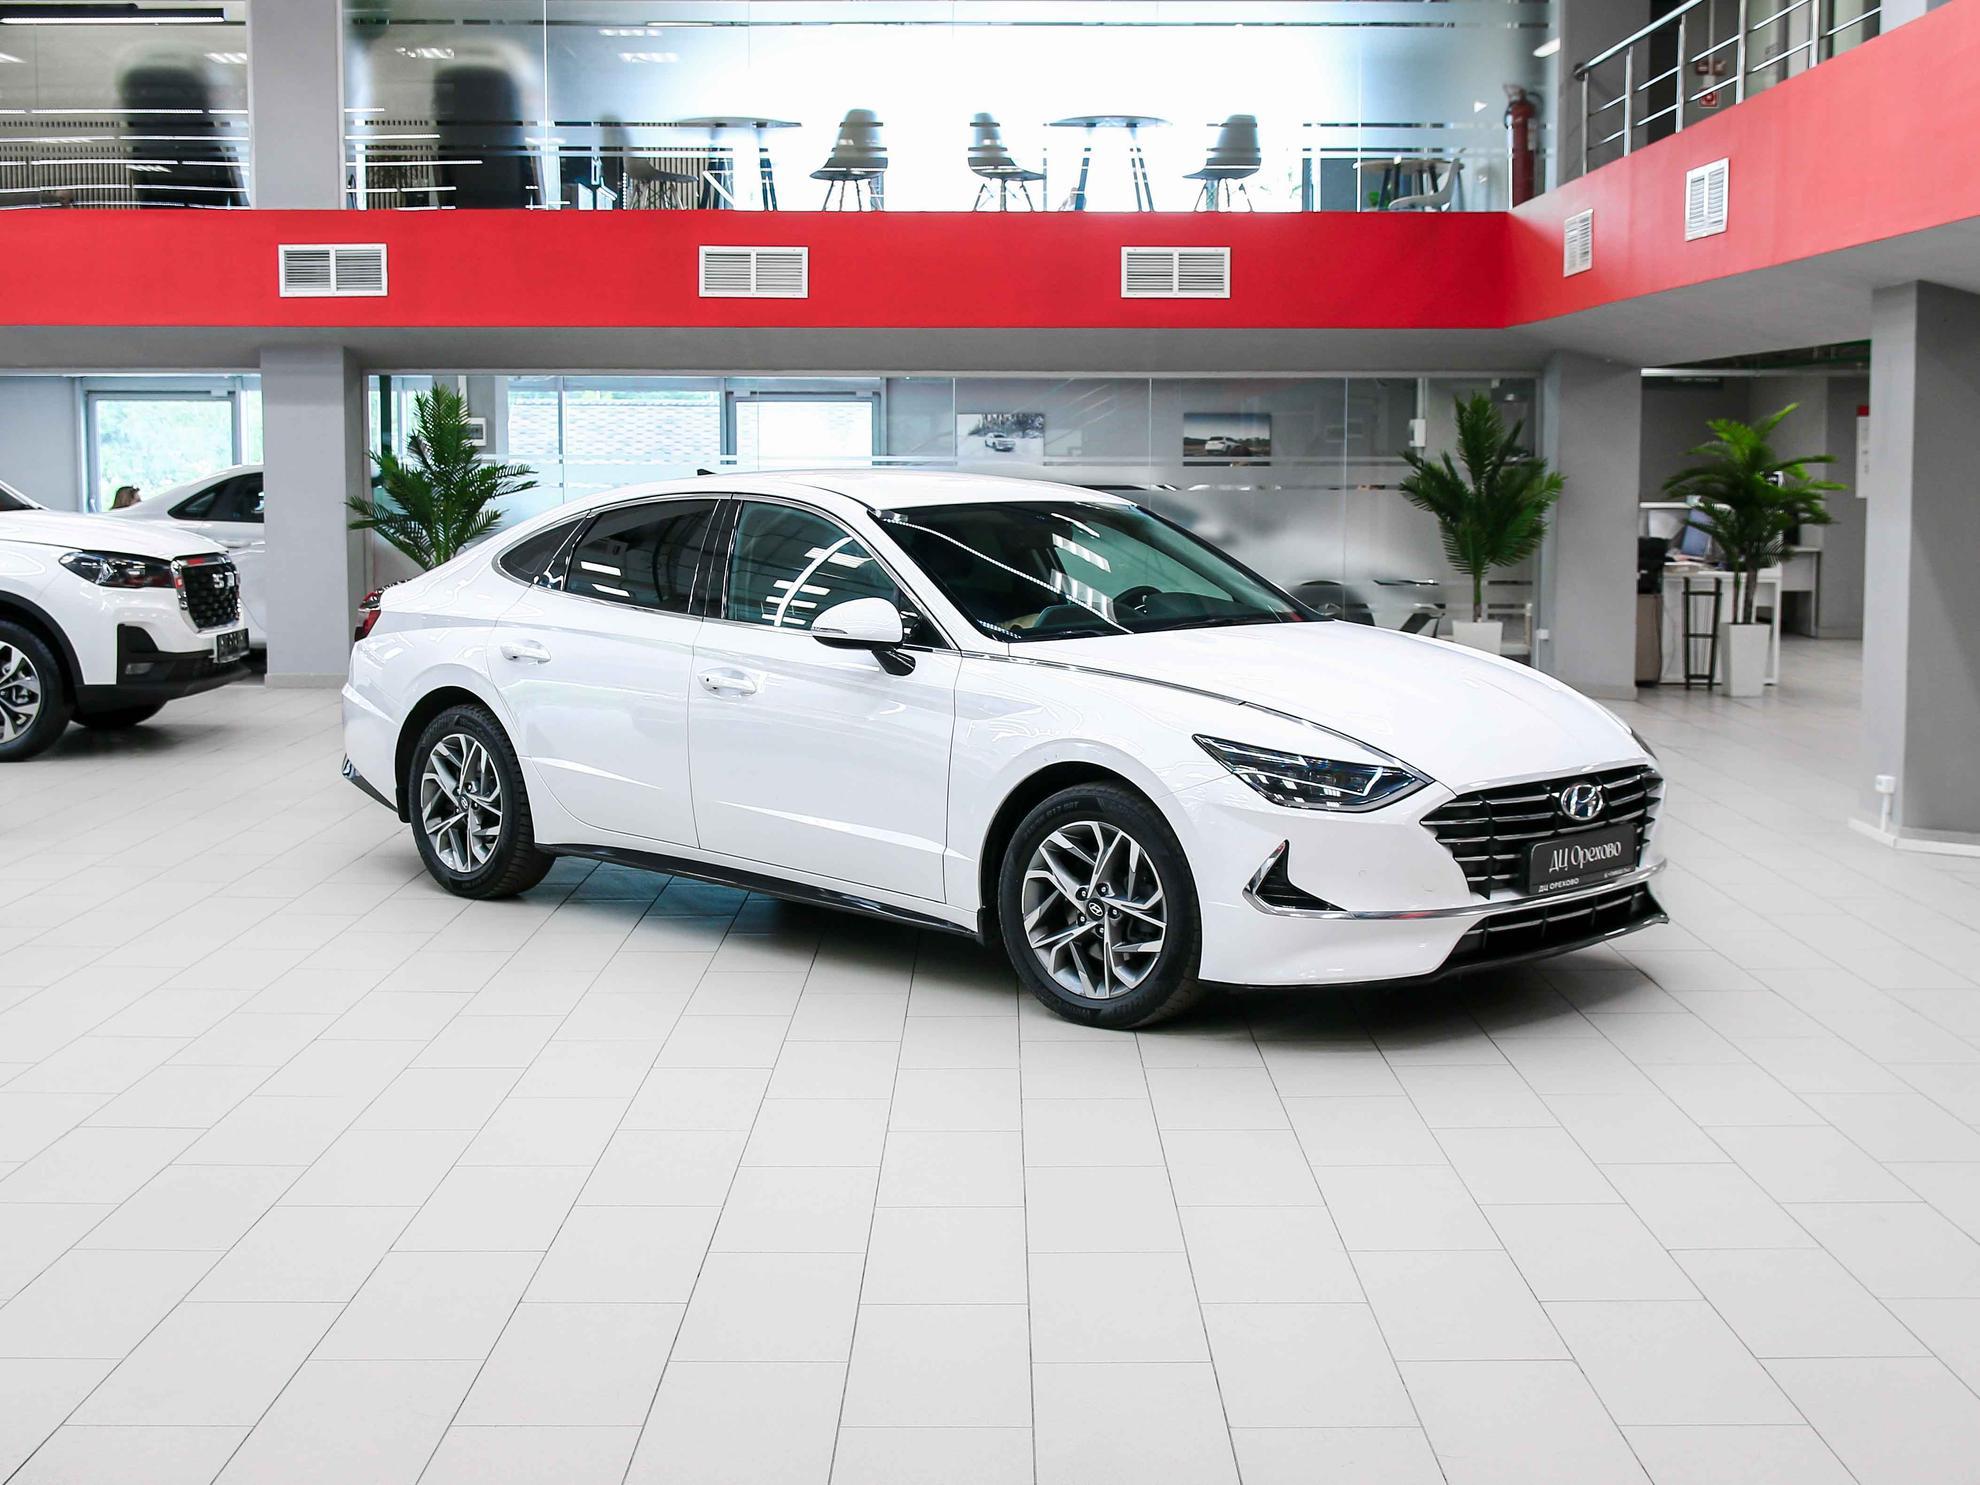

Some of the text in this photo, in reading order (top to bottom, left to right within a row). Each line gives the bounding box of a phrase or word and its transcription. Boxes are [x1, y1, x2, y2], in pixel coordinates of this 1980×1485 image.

[1549, 841, 1621, 873] ДЦ Орехово
[1549, 878, 1579, 889] ОРЕХОВО
